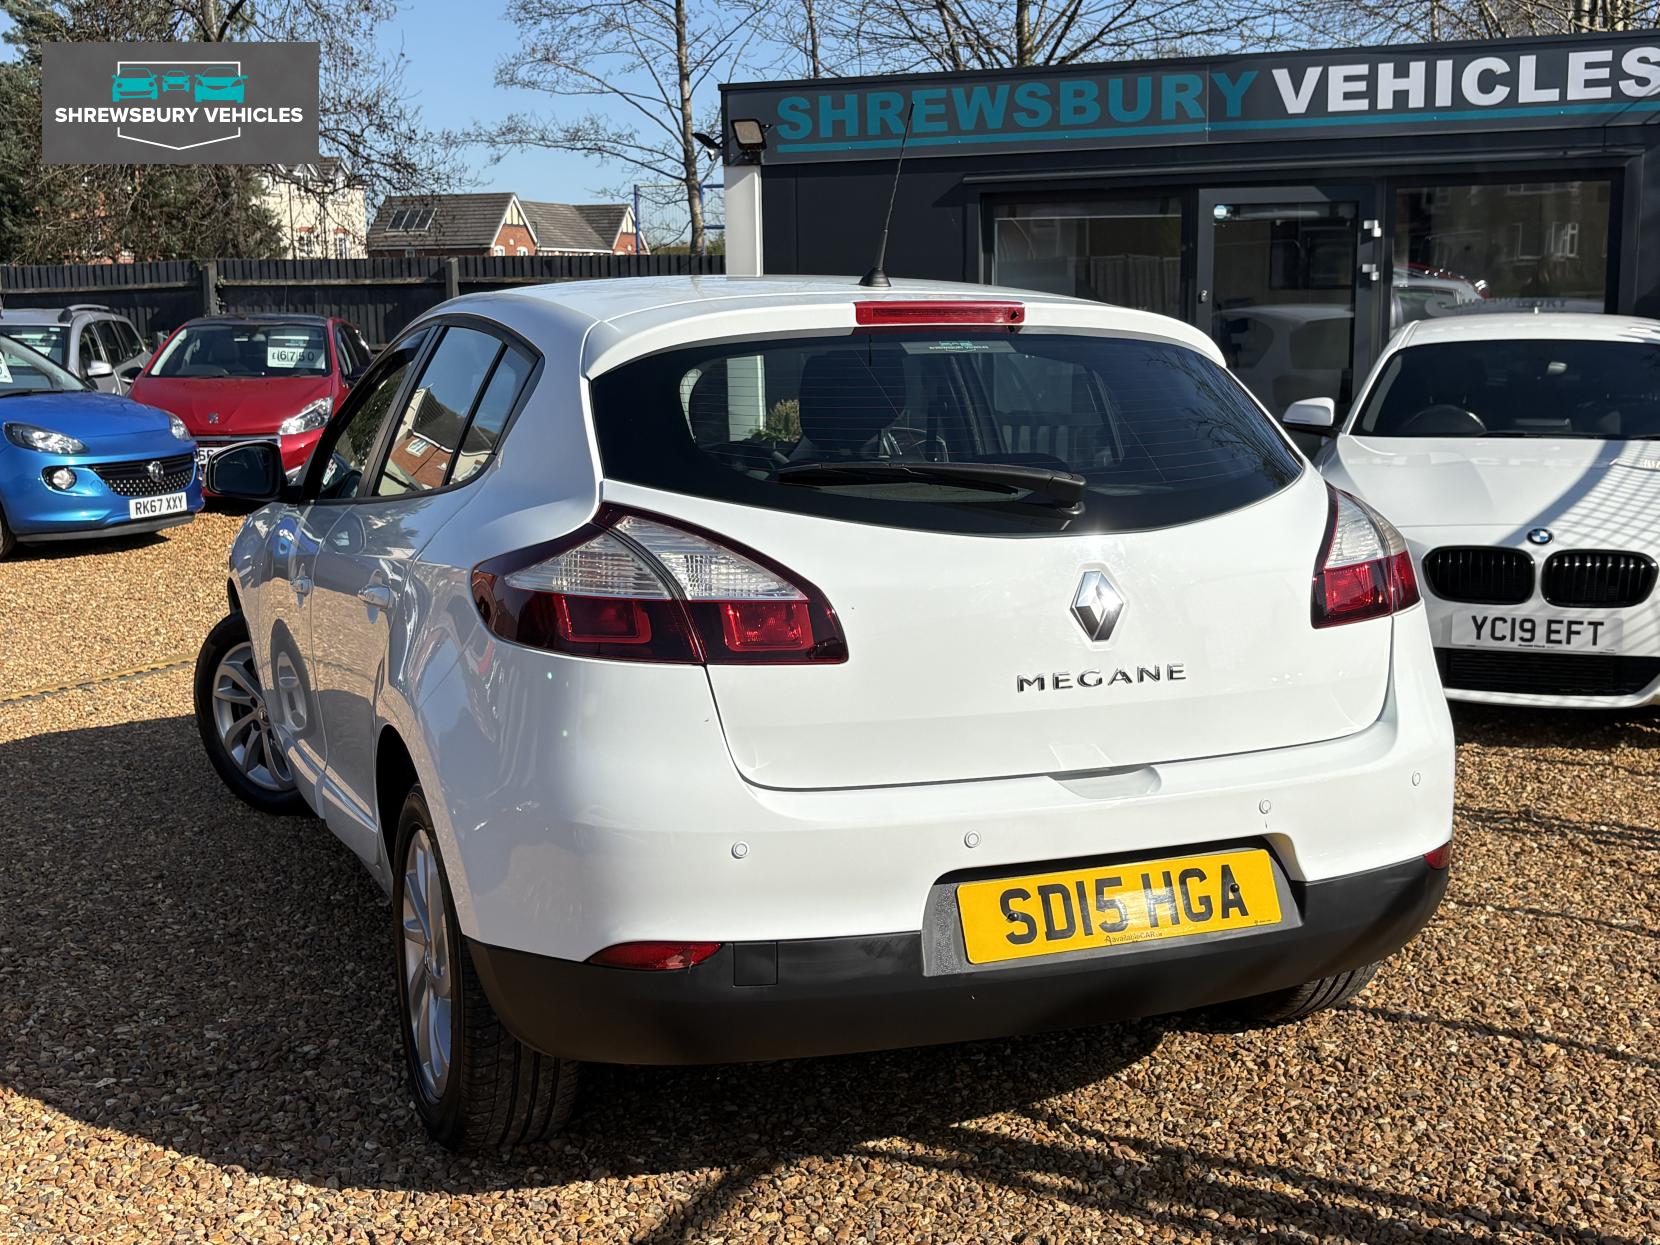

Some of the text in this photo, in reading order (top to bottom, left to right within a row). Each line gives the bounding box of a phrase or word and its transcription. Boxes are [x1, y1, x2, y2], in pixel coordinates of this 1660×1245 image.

[776, 46, 1660, 140] SHREWSBURY VEHICLES
[135, 495, 183, 516] RK67 XXY
[1471, 615, 1605, 646] YC19 EFT
[1016, 663, 1187, 693] MEGANE
[1000, 864, 1249, 945] SD15 HGA
